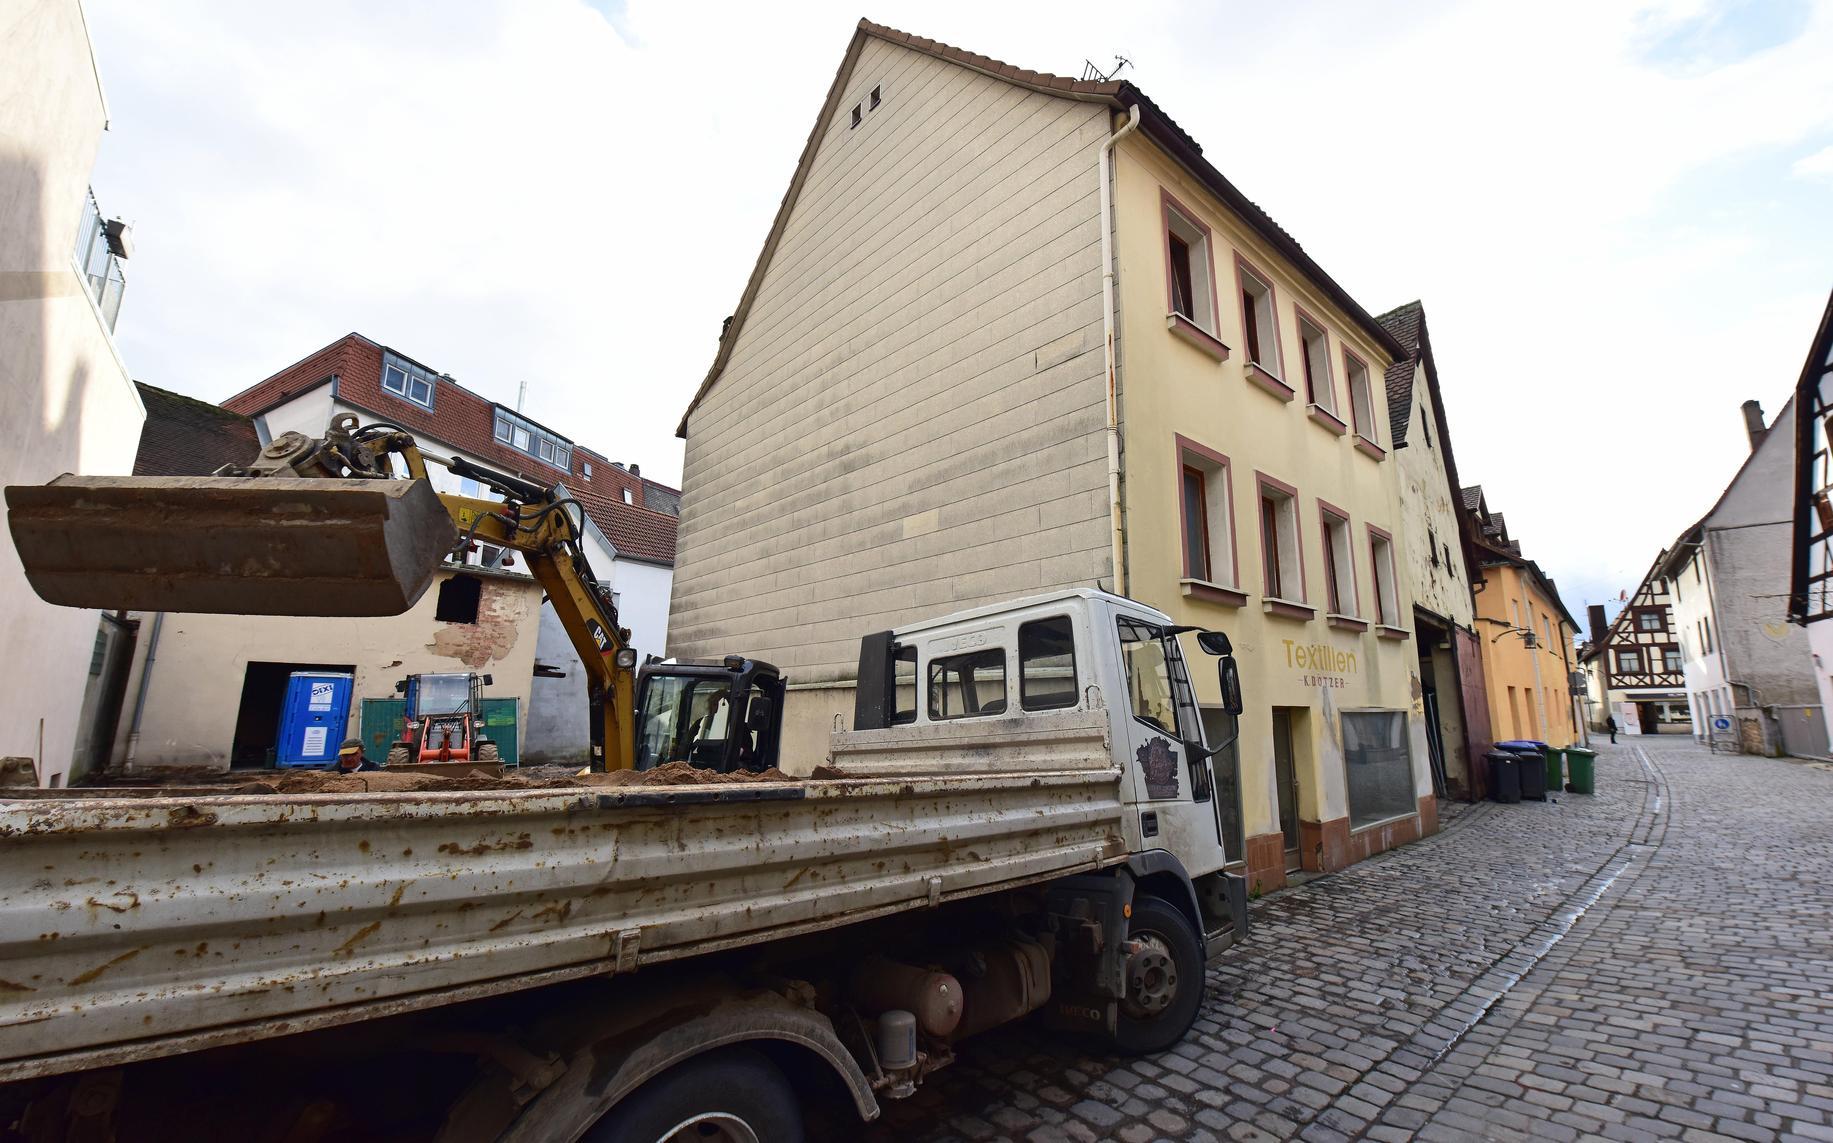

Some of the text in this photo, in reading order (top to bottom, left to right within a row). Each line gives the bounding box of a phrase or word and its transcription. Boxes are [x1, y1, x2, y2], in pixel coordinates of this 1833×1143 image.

[593, 625, 607, 651] CAT
[943, 632, 987, 653] IVECO
[312, 684, 333, 696] DIXI
